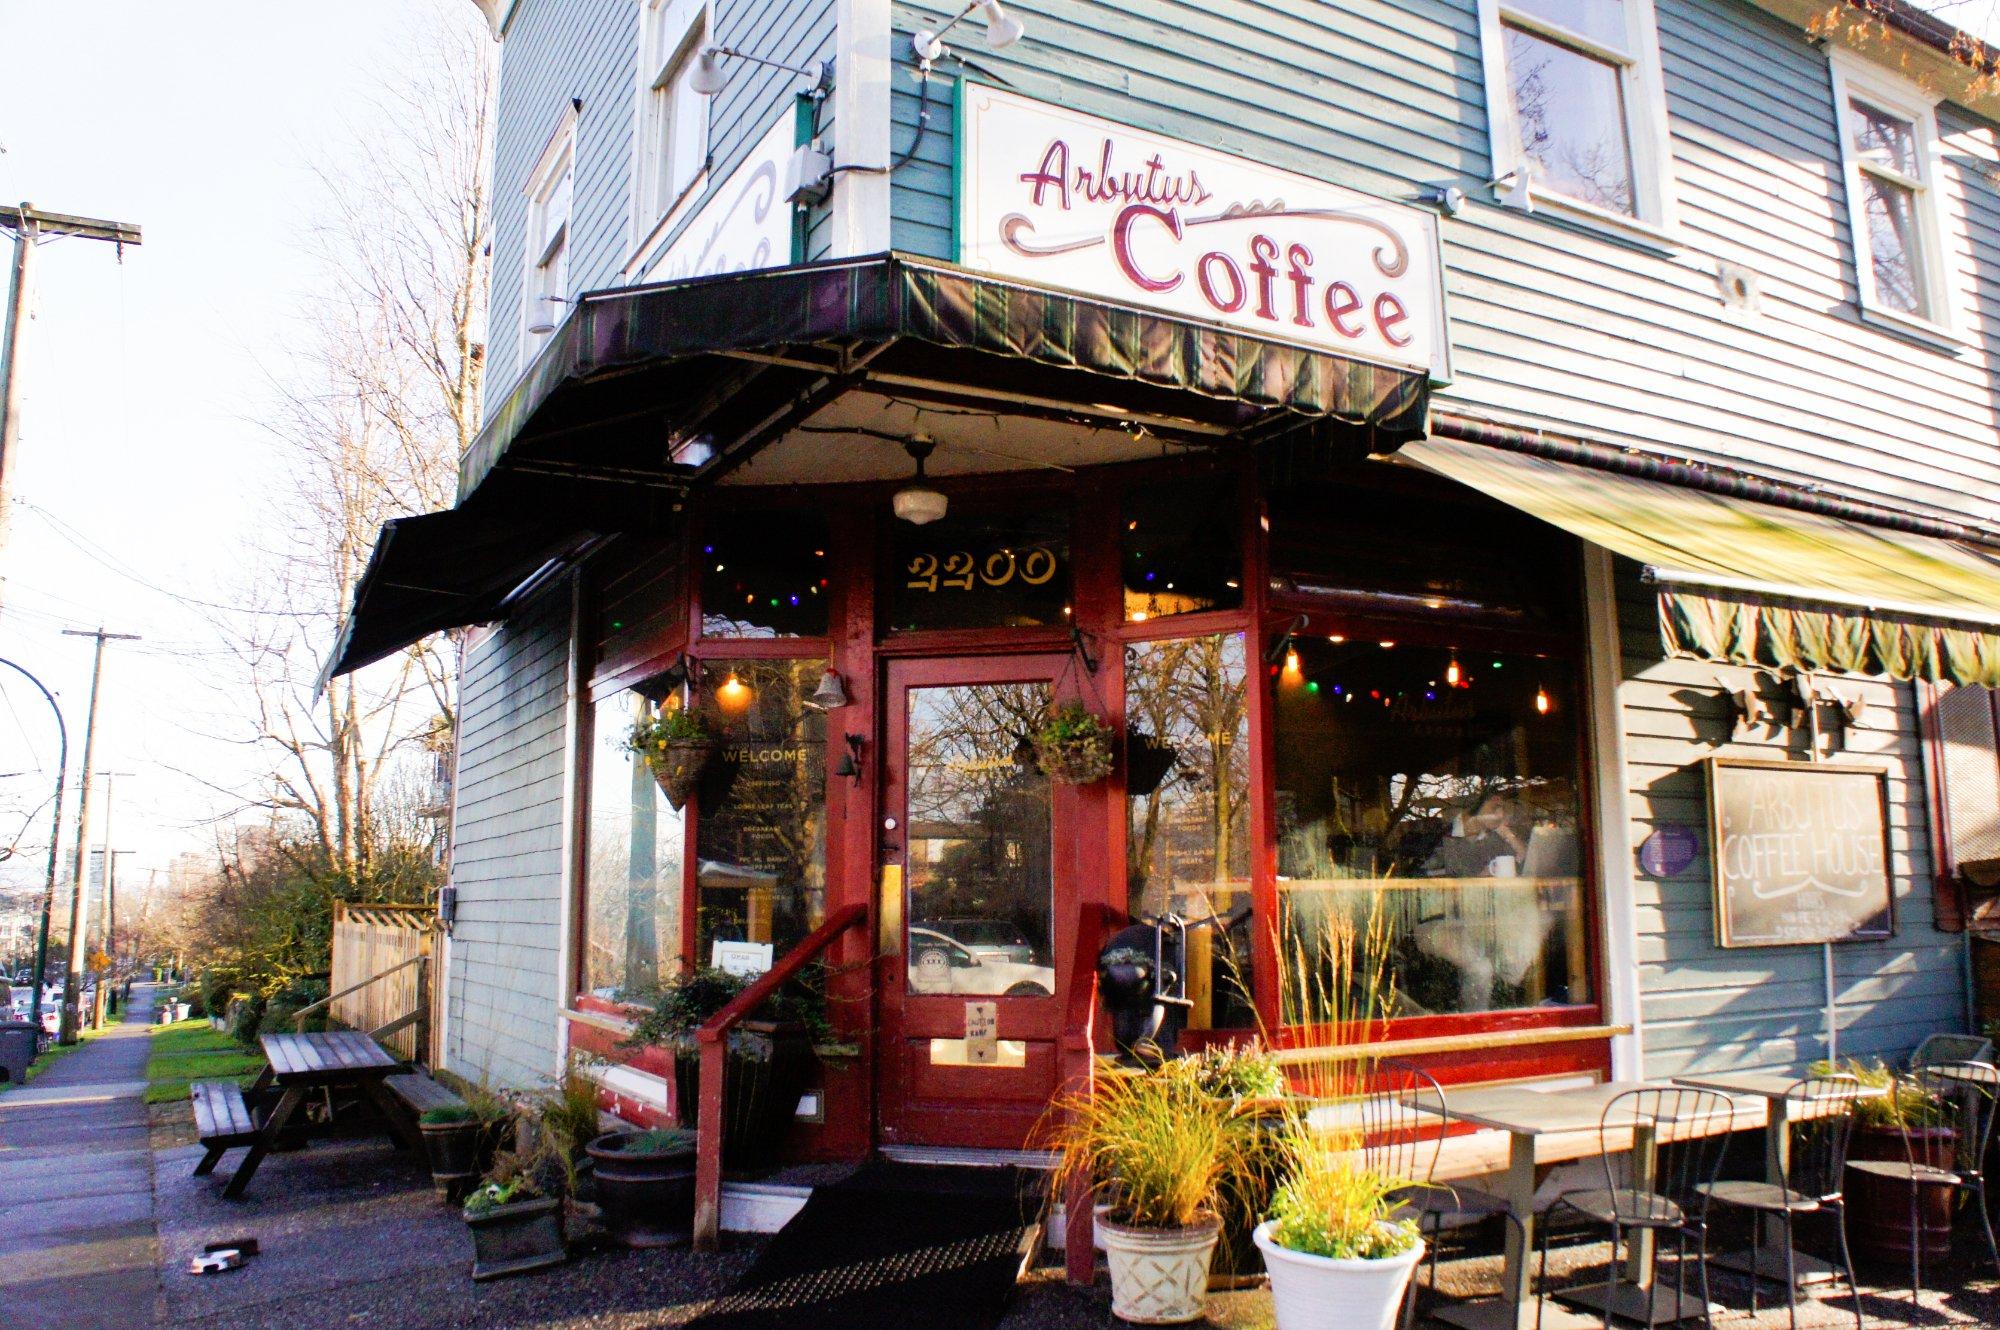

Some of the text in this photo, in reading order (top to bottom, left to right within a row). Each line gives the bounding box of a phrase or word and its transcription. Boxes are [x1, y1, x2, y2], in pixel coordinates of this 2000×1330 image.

[1020, 137, 1213, 210] Arbutus
[1112, 204, 1415, 348] Coffee
[907, 548, 1057, 592] 2200
[723, 749, 807, 763] WELCOME
[1145, 732, 1231, 750] WELCOME
[1748, 778, 1864, 831] ARBUTUS
[1724, 833, 1809, 880] COFFEE
[1810, 831, 1883, 876] HOUSE
